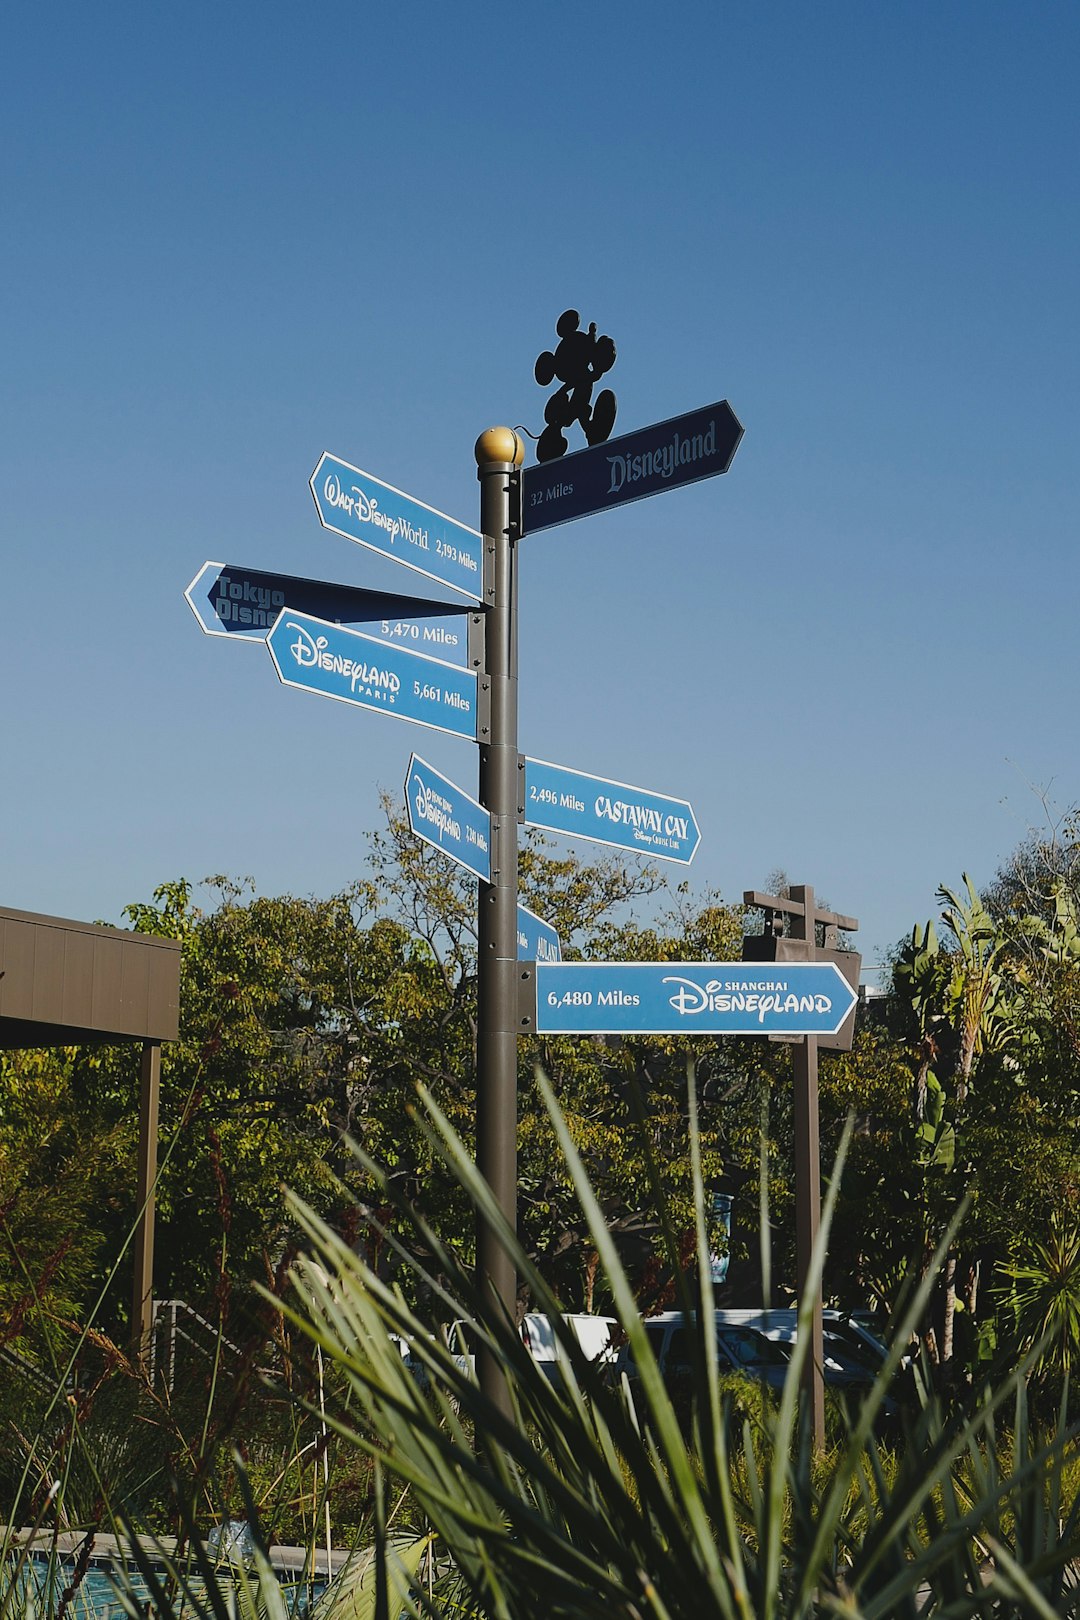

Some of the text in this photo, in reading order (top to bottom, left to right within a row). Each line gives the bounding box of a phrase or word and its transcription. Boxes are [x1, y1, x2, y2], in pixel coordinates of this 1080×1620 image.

[606, 420, 717, 495] Disneyland
[530, 482, 574, 507] 32 Miles
[398, 516, 429, 550] World
[435, 540, 478, 572] 2,193 Miles
[216, 575, 285, 609] Tokyo
[381, 620, 459, 645] 5,470 Miles
[358, 684, 396, 703] PARIS
[413, 681, 471, 712] 5,661 Miles
[530, 785, 585, 812] 2,496 Miles
[594, 796, 689, 840] CASTAWAY CAY
[547, 990, 640, 1008] 6,480 Miles
[724, 981, 788, 991] SHANGHAI
